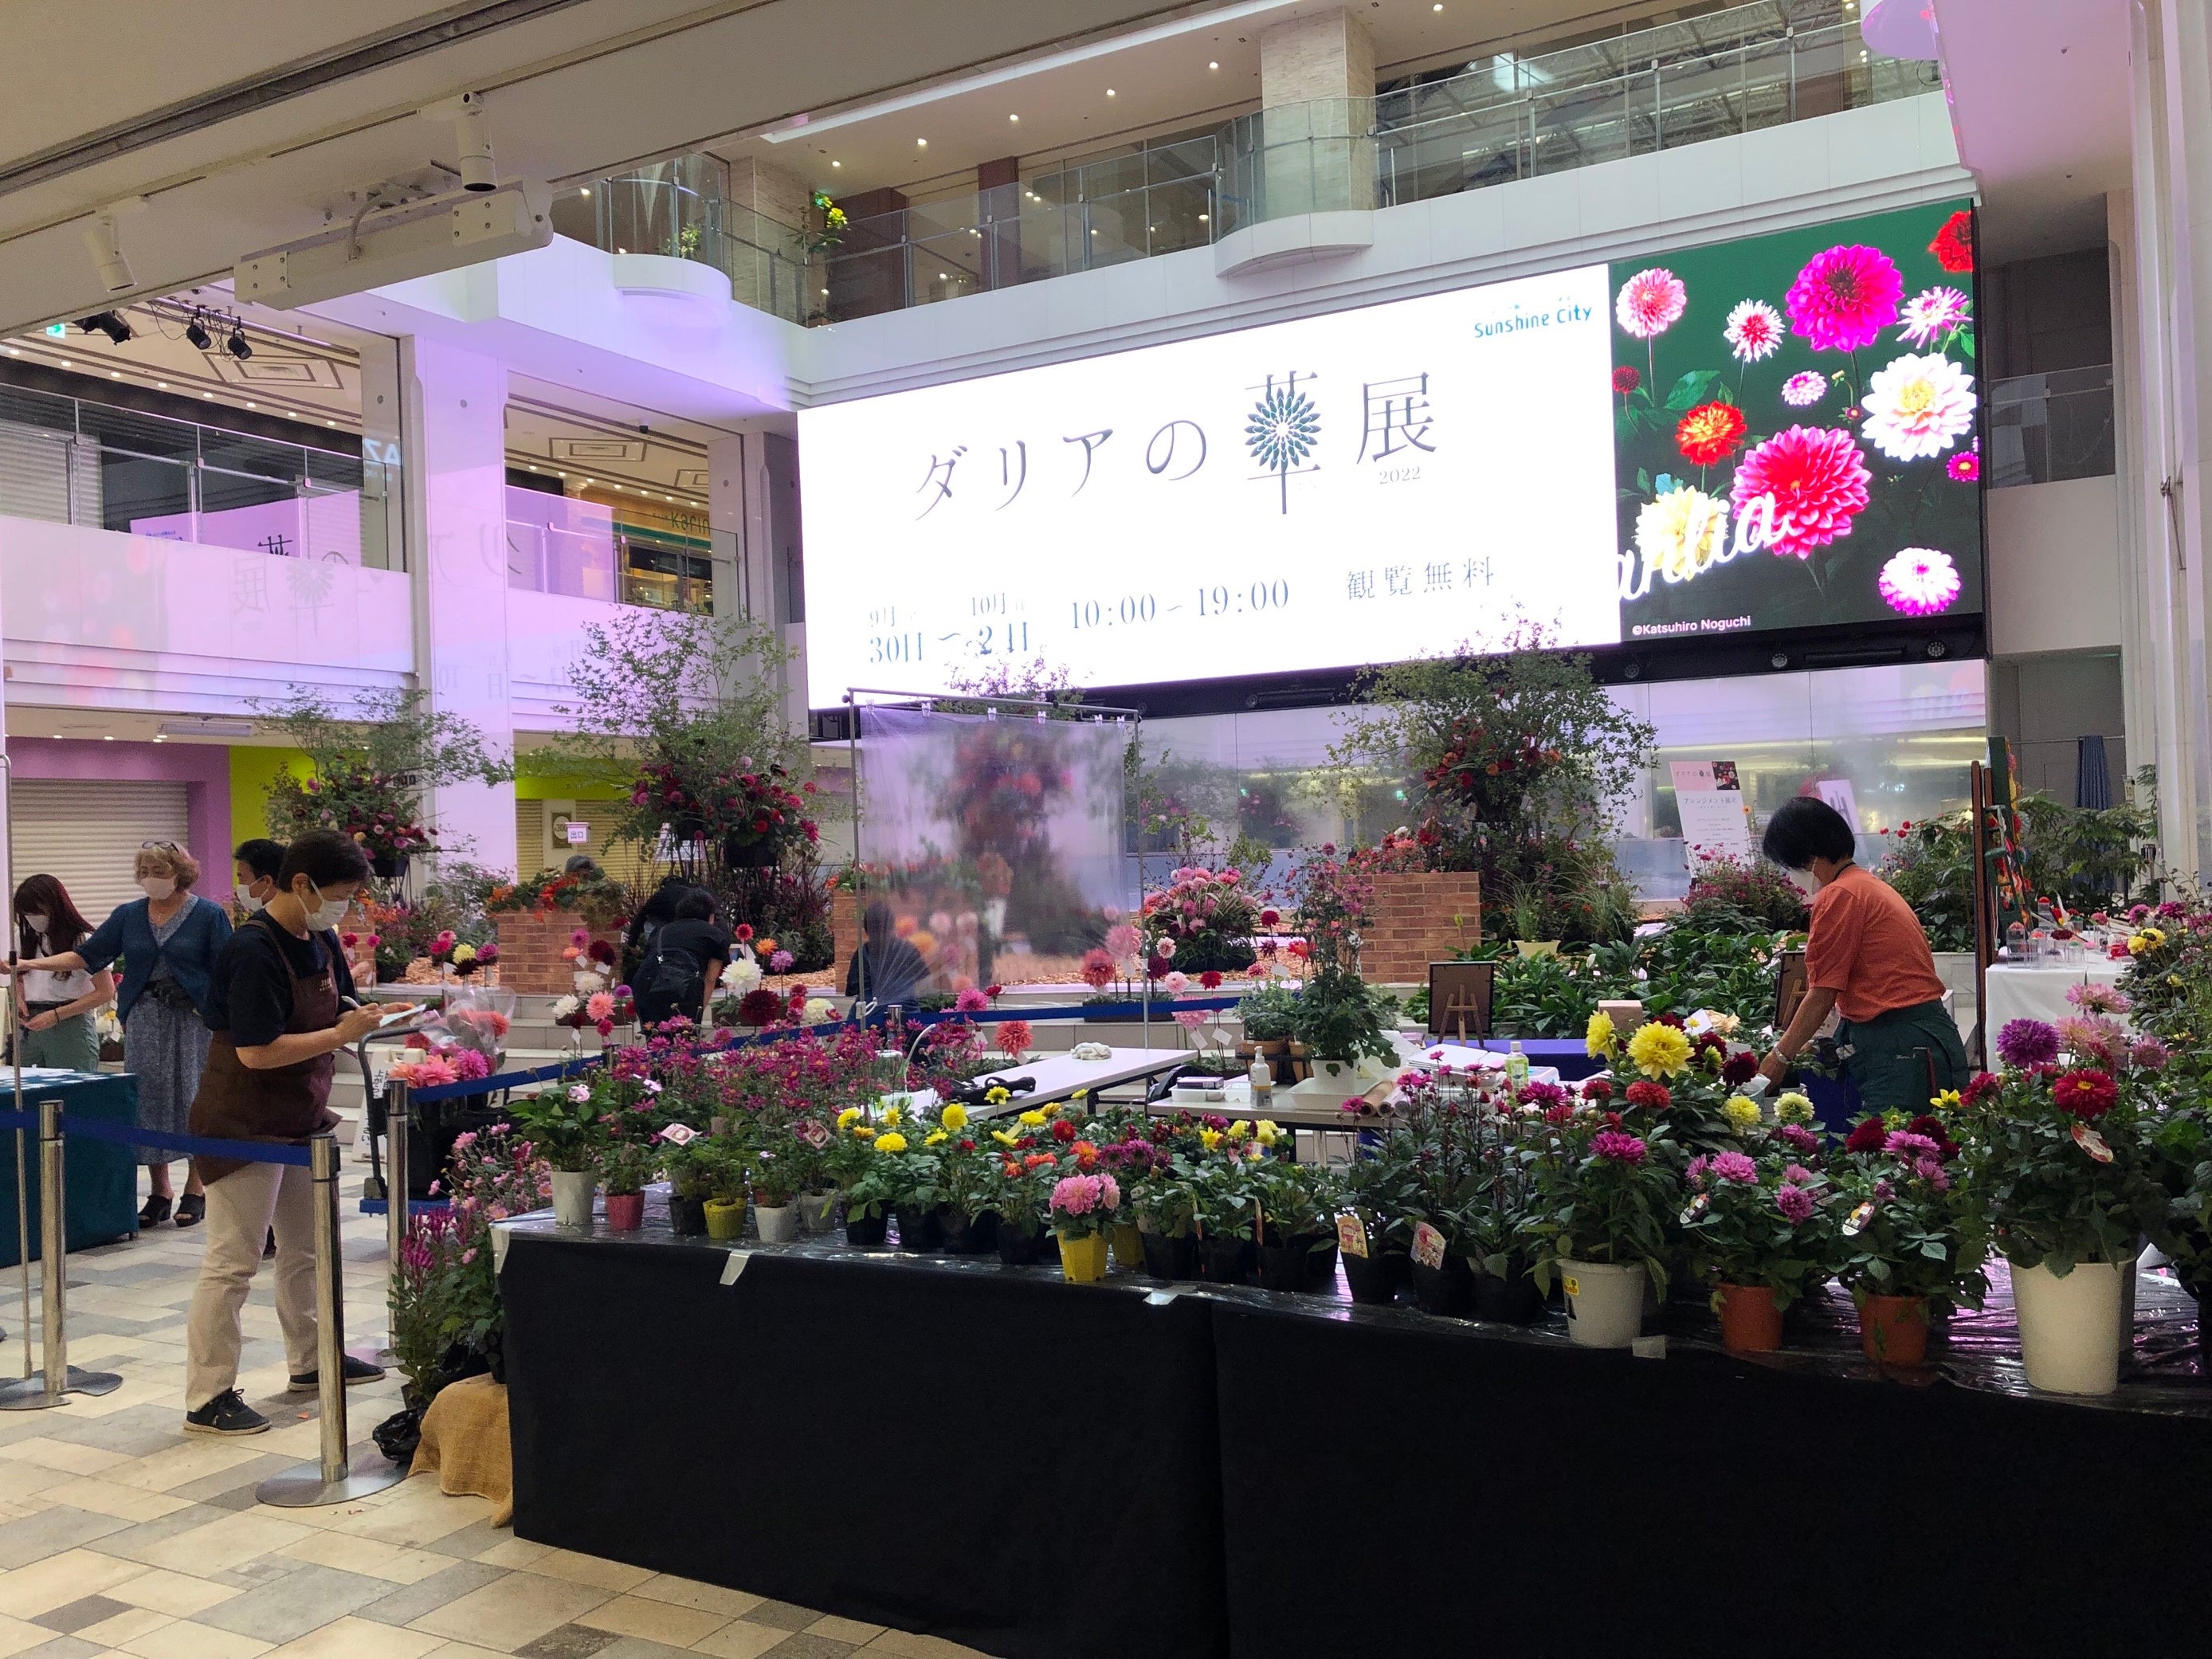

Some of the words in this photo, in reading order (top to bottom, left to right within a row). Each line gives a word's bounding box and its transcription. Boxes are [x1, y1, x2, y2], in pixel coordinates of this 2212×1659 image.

[1474, 314, 1550, 338] Sunshine
[1556, 304, 1592, 324] City
[914, 369, 1437, 520] ダリアの華展
[1379, 466, 1421, 484] 2022
[1347, 556, 1495, 601] 観覧無料
[1700, 615, 1751, 631] Noguchi
